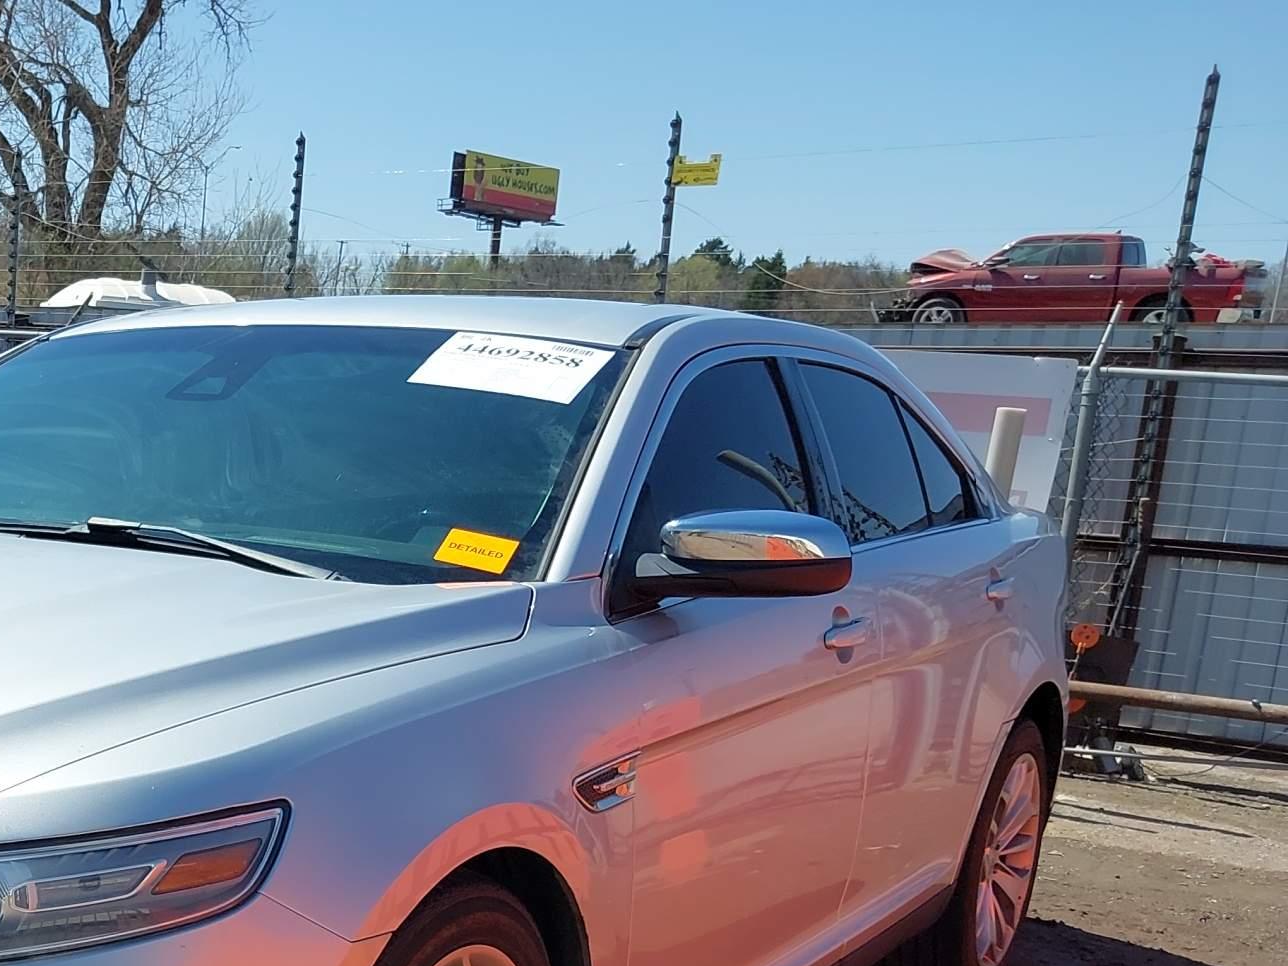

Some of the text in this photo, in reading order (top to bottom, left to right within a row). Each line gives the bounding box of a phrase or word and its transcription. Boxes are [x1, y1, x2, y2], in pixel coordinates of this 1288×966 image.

[491, 176, 510, 188] UGLY
[456, 343, 584, 368] 44692858
[448, 541, 504, 559] DETAILED
